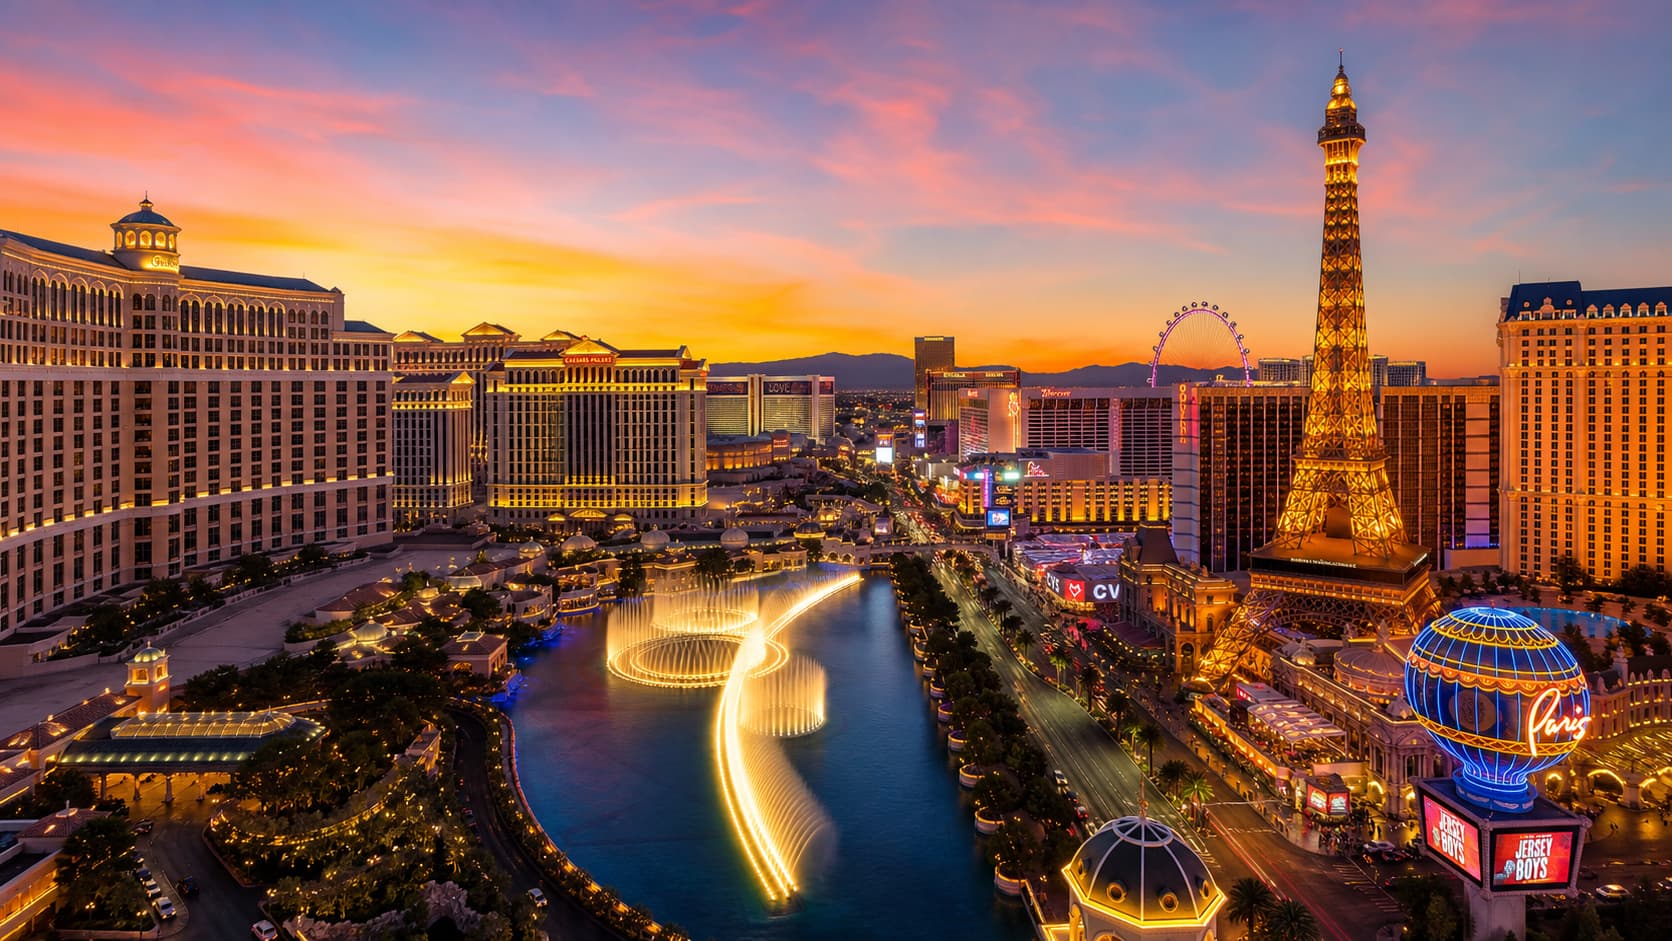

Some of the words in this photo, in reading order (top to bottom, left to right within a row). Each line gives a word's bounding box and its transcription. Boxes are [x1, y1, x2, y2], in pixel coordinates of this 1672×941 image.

[768, 383, 791, 393] LOVE
[1093, 584, 1120, 599] CV
[1529, 687, 1592, 757] Paris
[1439, 811, 1465, 843] JERSEY
[1441, 831, 1465, 865] BOYS
[1515, 838, 1553, 859] JERSEY
[1515, 857, 1548, 881] BOYS
